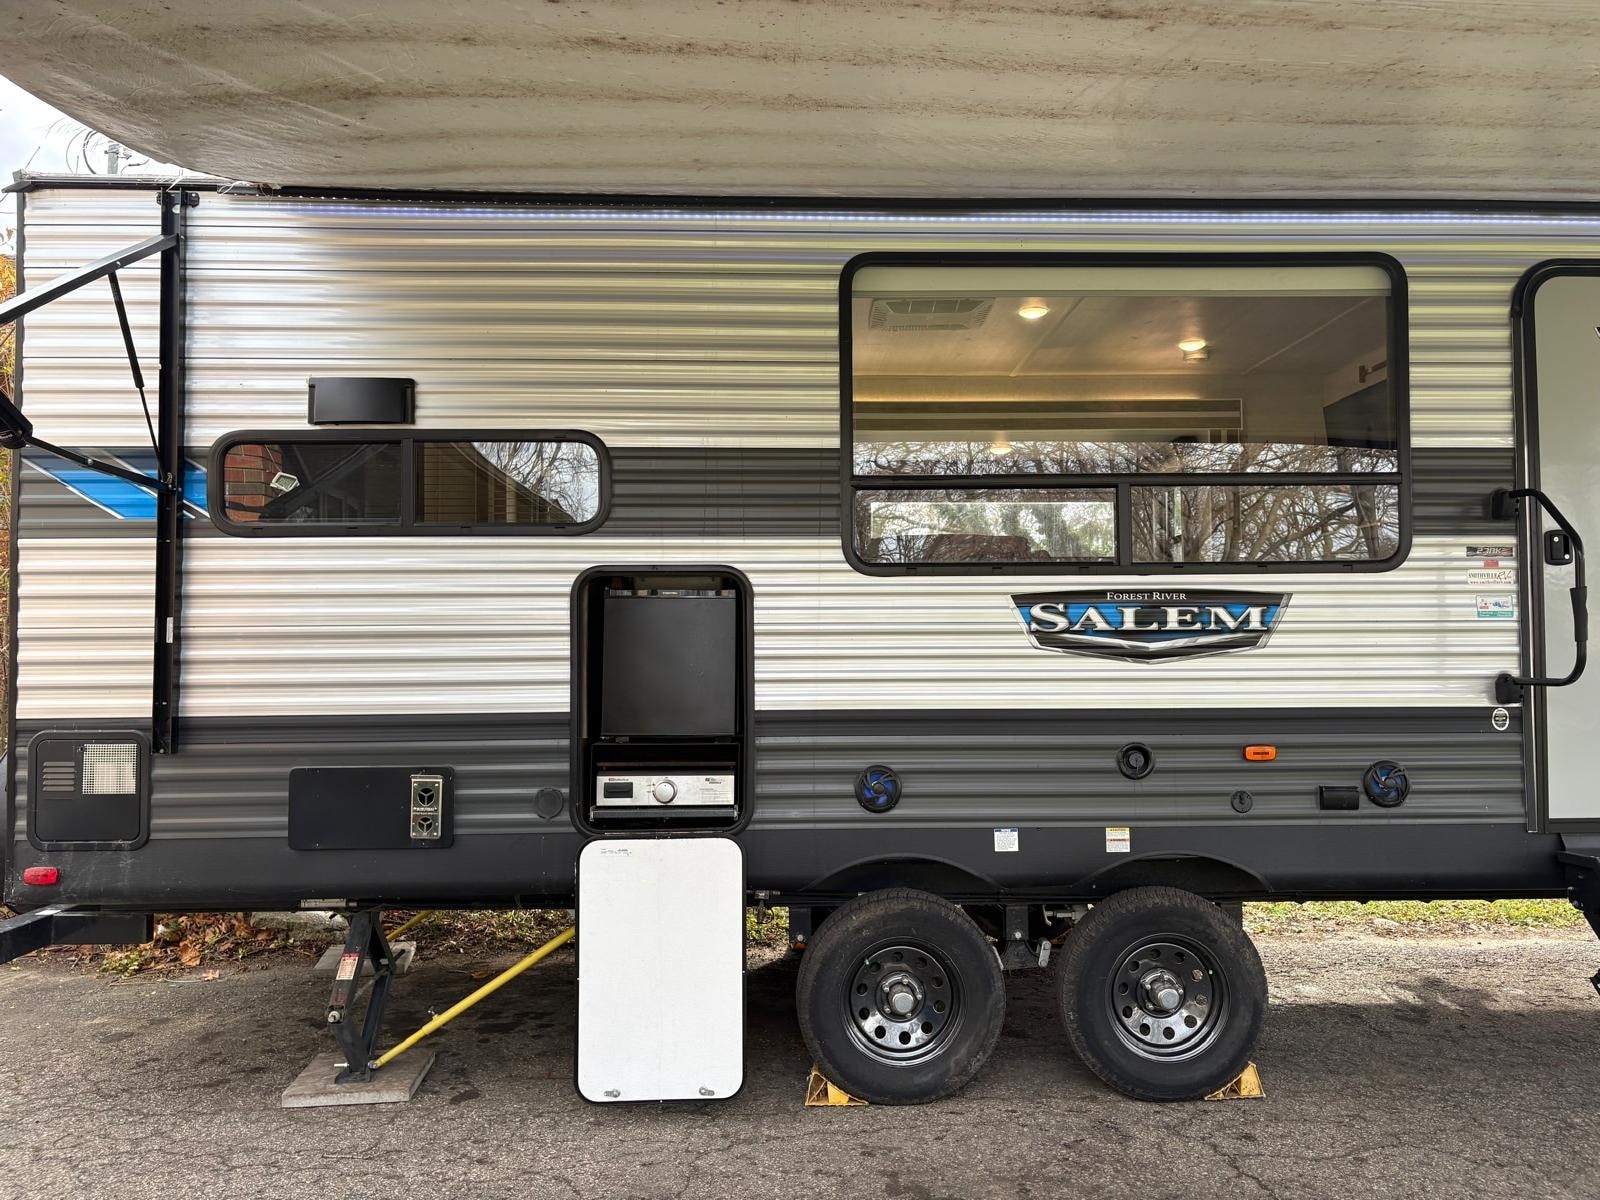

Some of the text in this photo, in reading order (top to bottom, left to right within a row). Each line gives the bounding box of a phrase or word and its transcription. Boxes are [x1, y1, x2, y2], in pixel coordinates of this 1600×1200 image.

[1106, 591, 1187, 600] FOREST RIVER
[1029, 603, 1268, 633] SALEM
